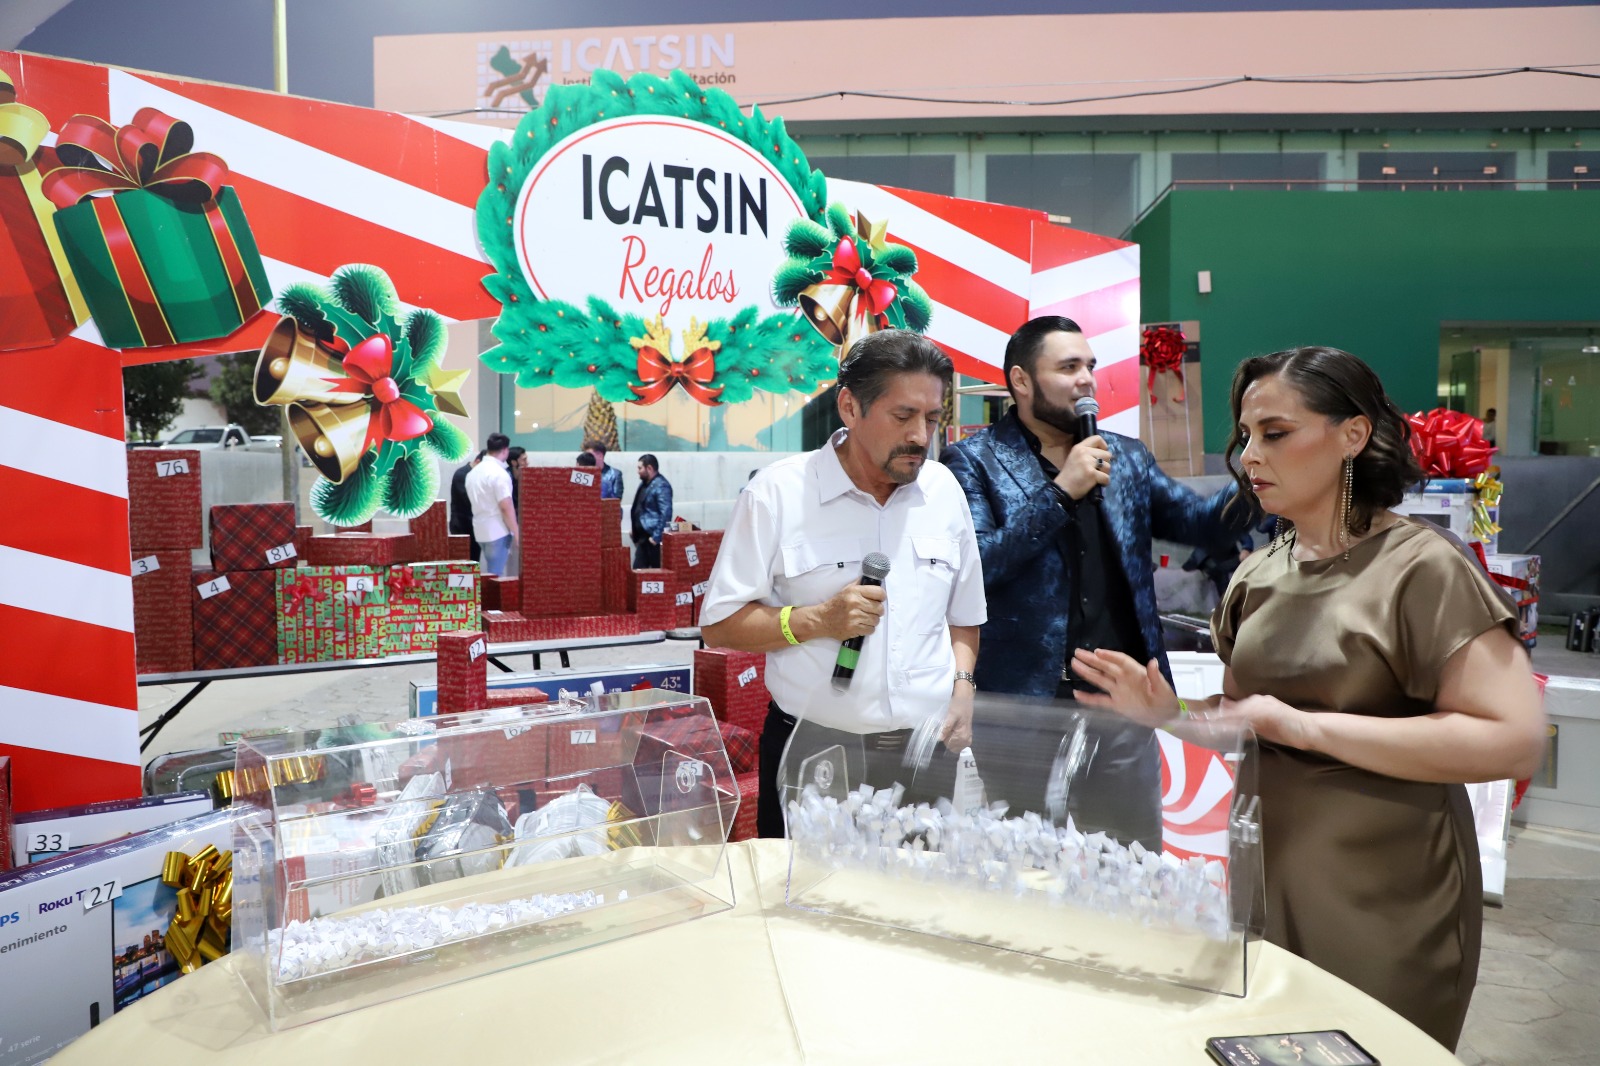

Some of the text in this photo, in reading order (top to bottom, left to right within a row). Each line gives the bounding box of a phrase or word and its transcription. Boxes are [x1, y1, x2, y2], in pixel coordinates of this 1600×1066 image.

[561, 33, 735, 72] ICATSIN
[582, 153, 768, 239] ICATSIN
[619, 235, 740, 317] Regalos
[162, 461, 184, 476] 76
[575, 472, 590, 485] 85
[137, 560, 148, 573] 3
[210, 581, 219, 593] 4
[356, 579, 364, 591] 6
[458, 575, 464, 586] 7
[646, 582, 660, 593] 53
[441, 590, 474, 601] FELIZ
[676, 593, 689, 604] 42
[334, 581, 346, 641] NAVIDAD
[420, 604, 465, 614] NAVIDAD
[427, 621, 458, 632] FELIZ
[741, 670, 755, 683] 66
[575, 731, 592, 743] 77
[34, 834, 62, 851] 33
[90, 881, 115, 906] 27
[39, 896, 73, 914] Roku
[0, 925, 67, 953] enimiento
